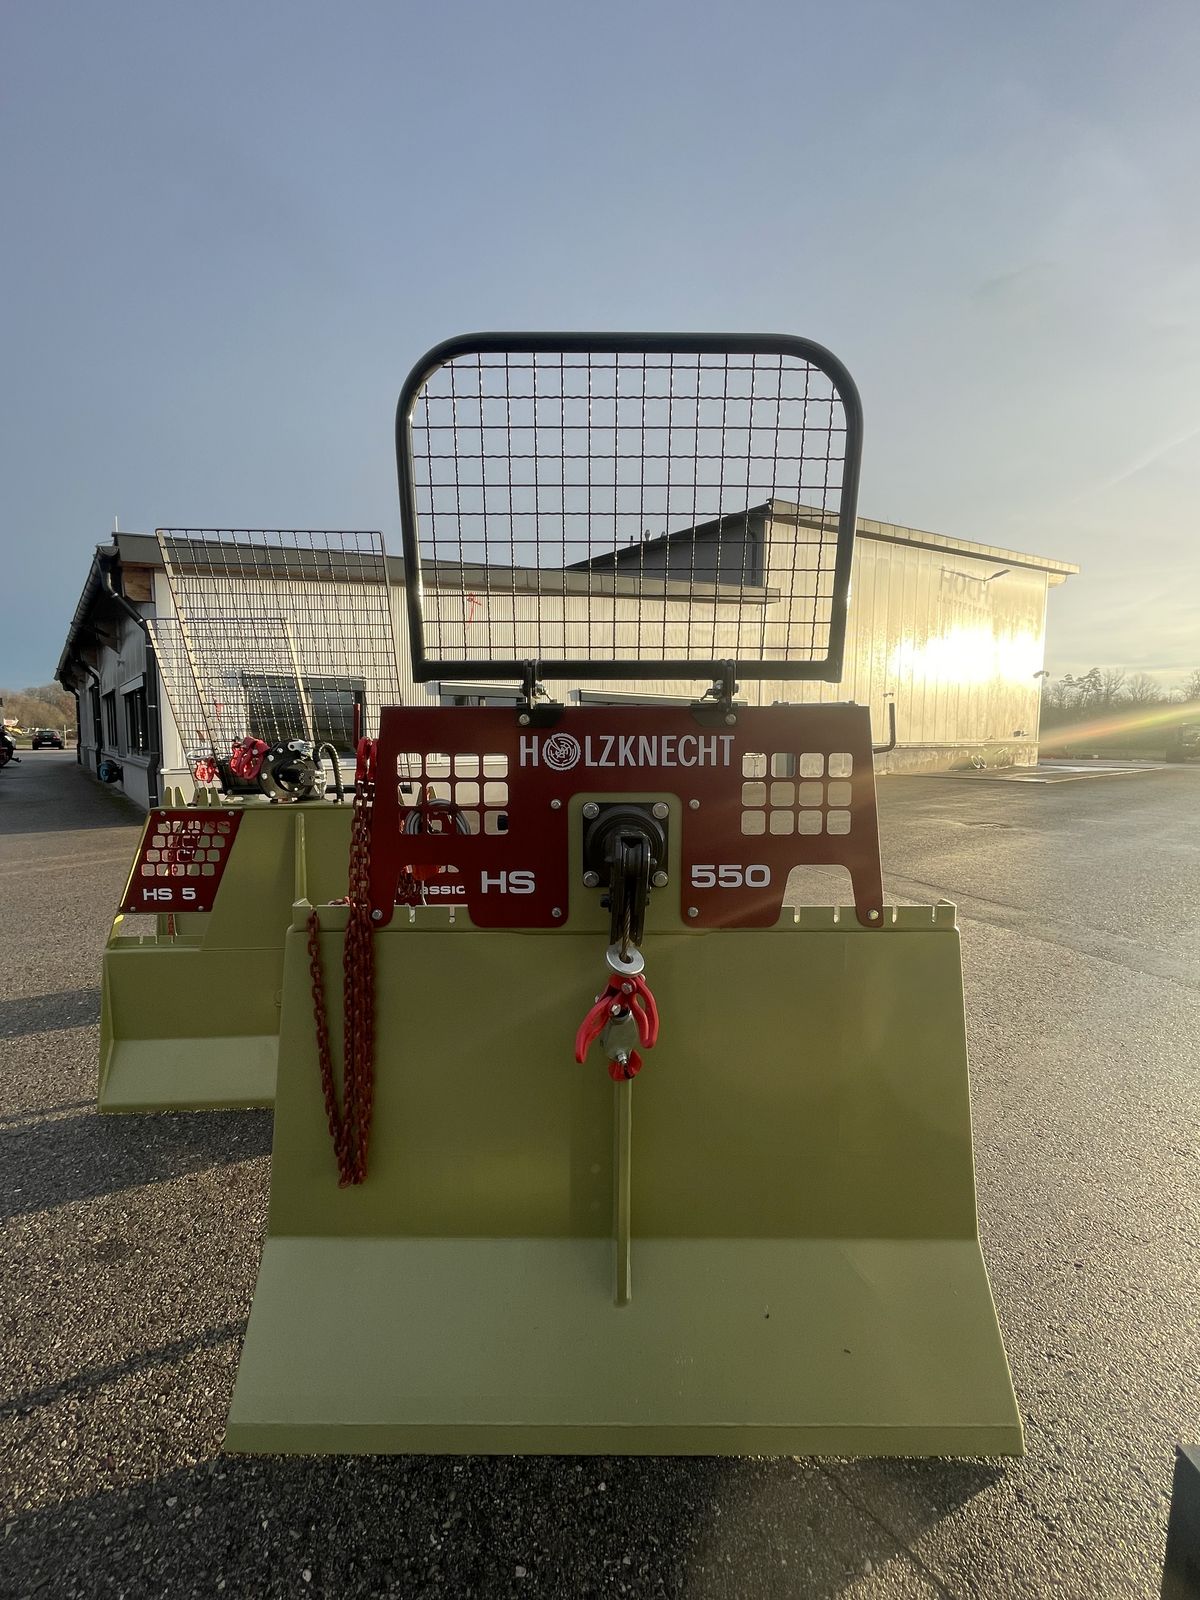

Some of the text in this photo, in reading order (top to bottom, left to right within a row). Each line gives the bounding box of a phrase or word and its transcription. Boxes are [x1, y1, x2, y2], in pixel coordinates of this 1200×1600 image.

[519, 732, 736, 771] HOLZKNECHT
[142, 887, 197, 901] HS 5
[480, 864, 771, 894] HS 550
